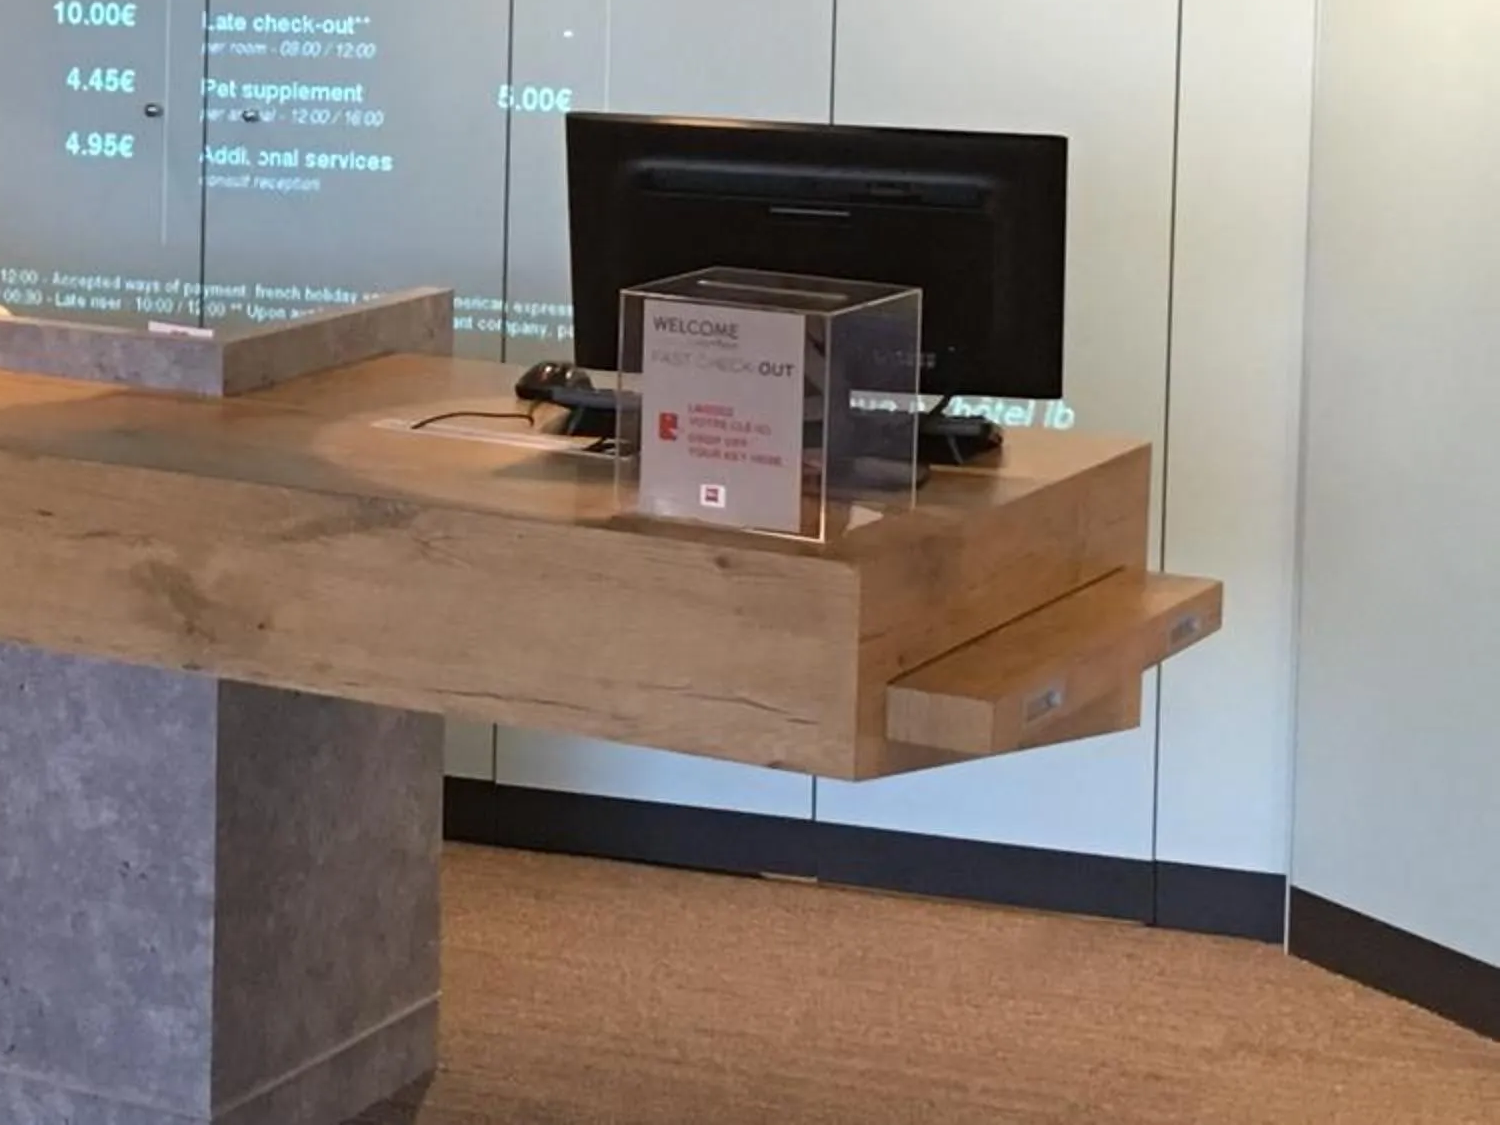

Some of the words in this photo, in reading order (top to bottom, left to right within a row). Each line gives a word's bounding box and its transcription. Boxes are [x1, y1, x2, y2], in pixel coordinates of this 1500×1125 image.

[52, 0, 138, 27] 10.00€
[201, 11, 248, 32] Late
[66, 67, 137, 93] 4.45€
[200, 77, 236, 99] Pet
[241, 81, 365, 106] supplement
[497, 84, 573, 112] 5.00€
[65, 131, 136, 158] 4.95€
[304, 152, 395, 172] services
[247, 303, 286, 323] Upon
[653, 317, 740, 340] WELCOME
